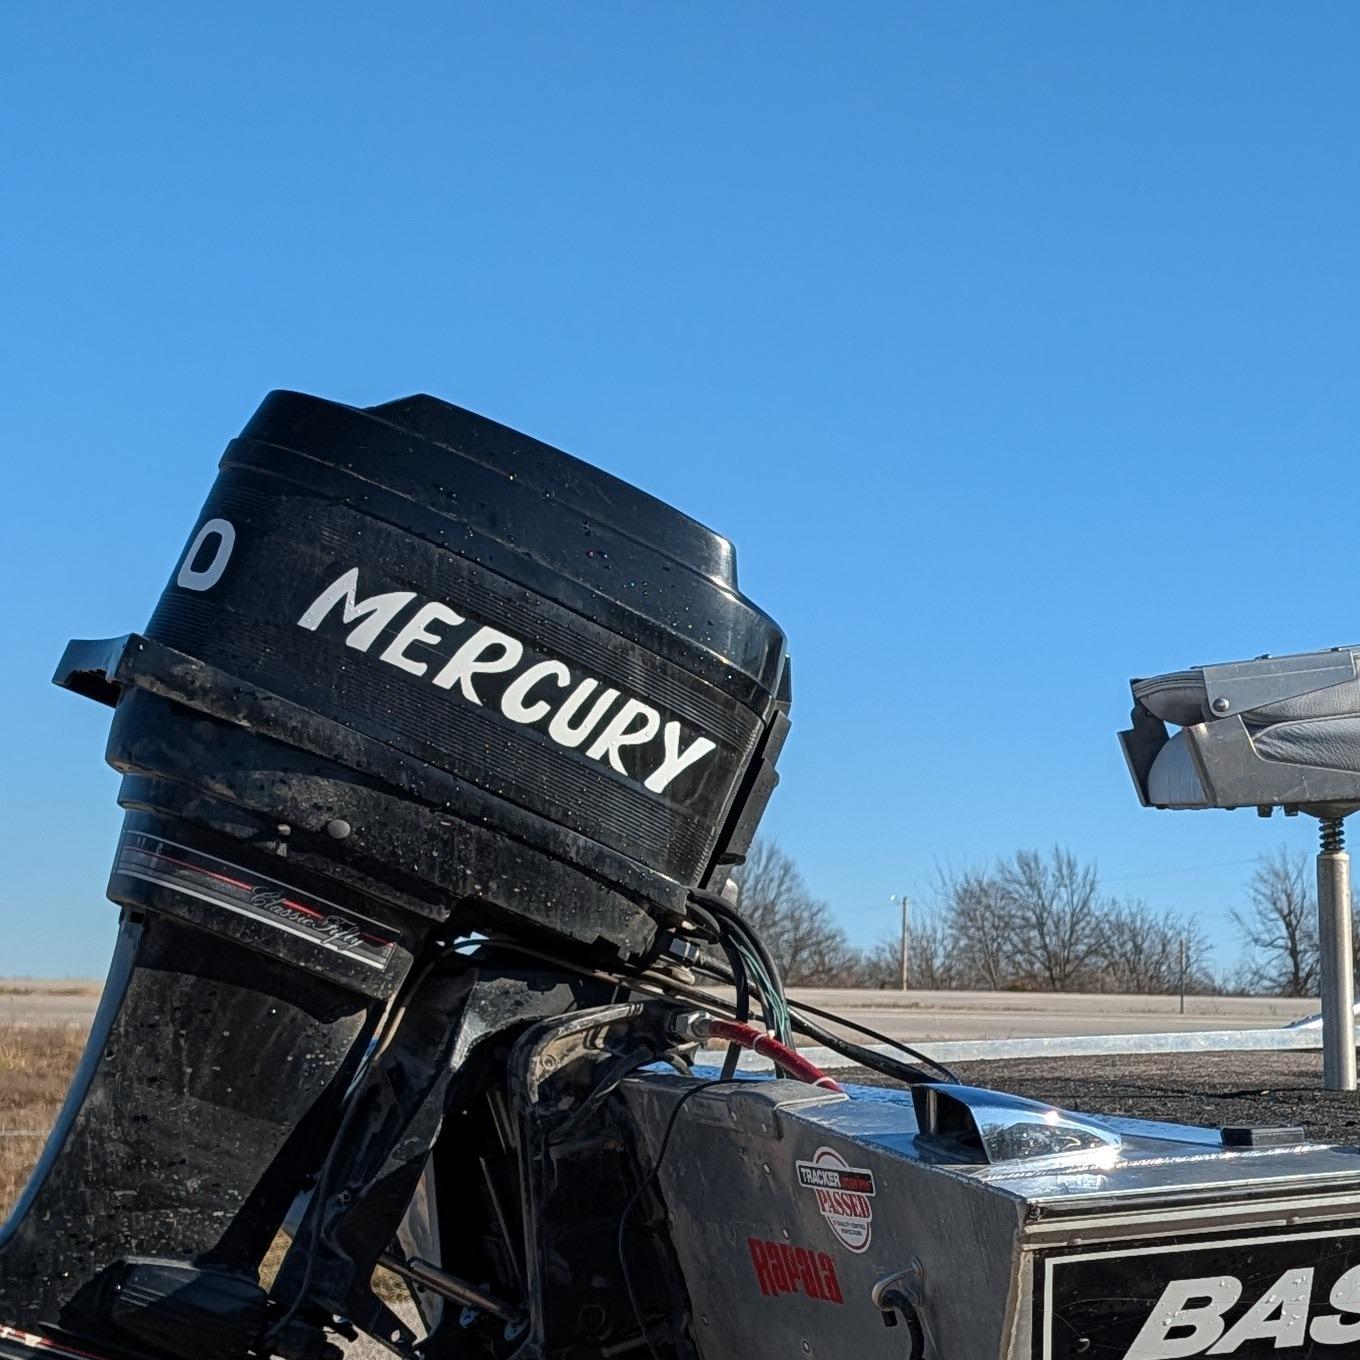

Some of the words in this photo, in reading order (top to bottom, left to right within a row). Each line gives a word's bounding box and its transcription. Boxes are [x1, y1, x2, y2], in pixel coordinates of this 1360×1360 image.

[297, 567, 717, 794] MERCURY
[250, 885, 326, 931] Classic
[801, 1167, 841, 1188] TRACKER
[816, 1188, 871, 1219] PASSED
